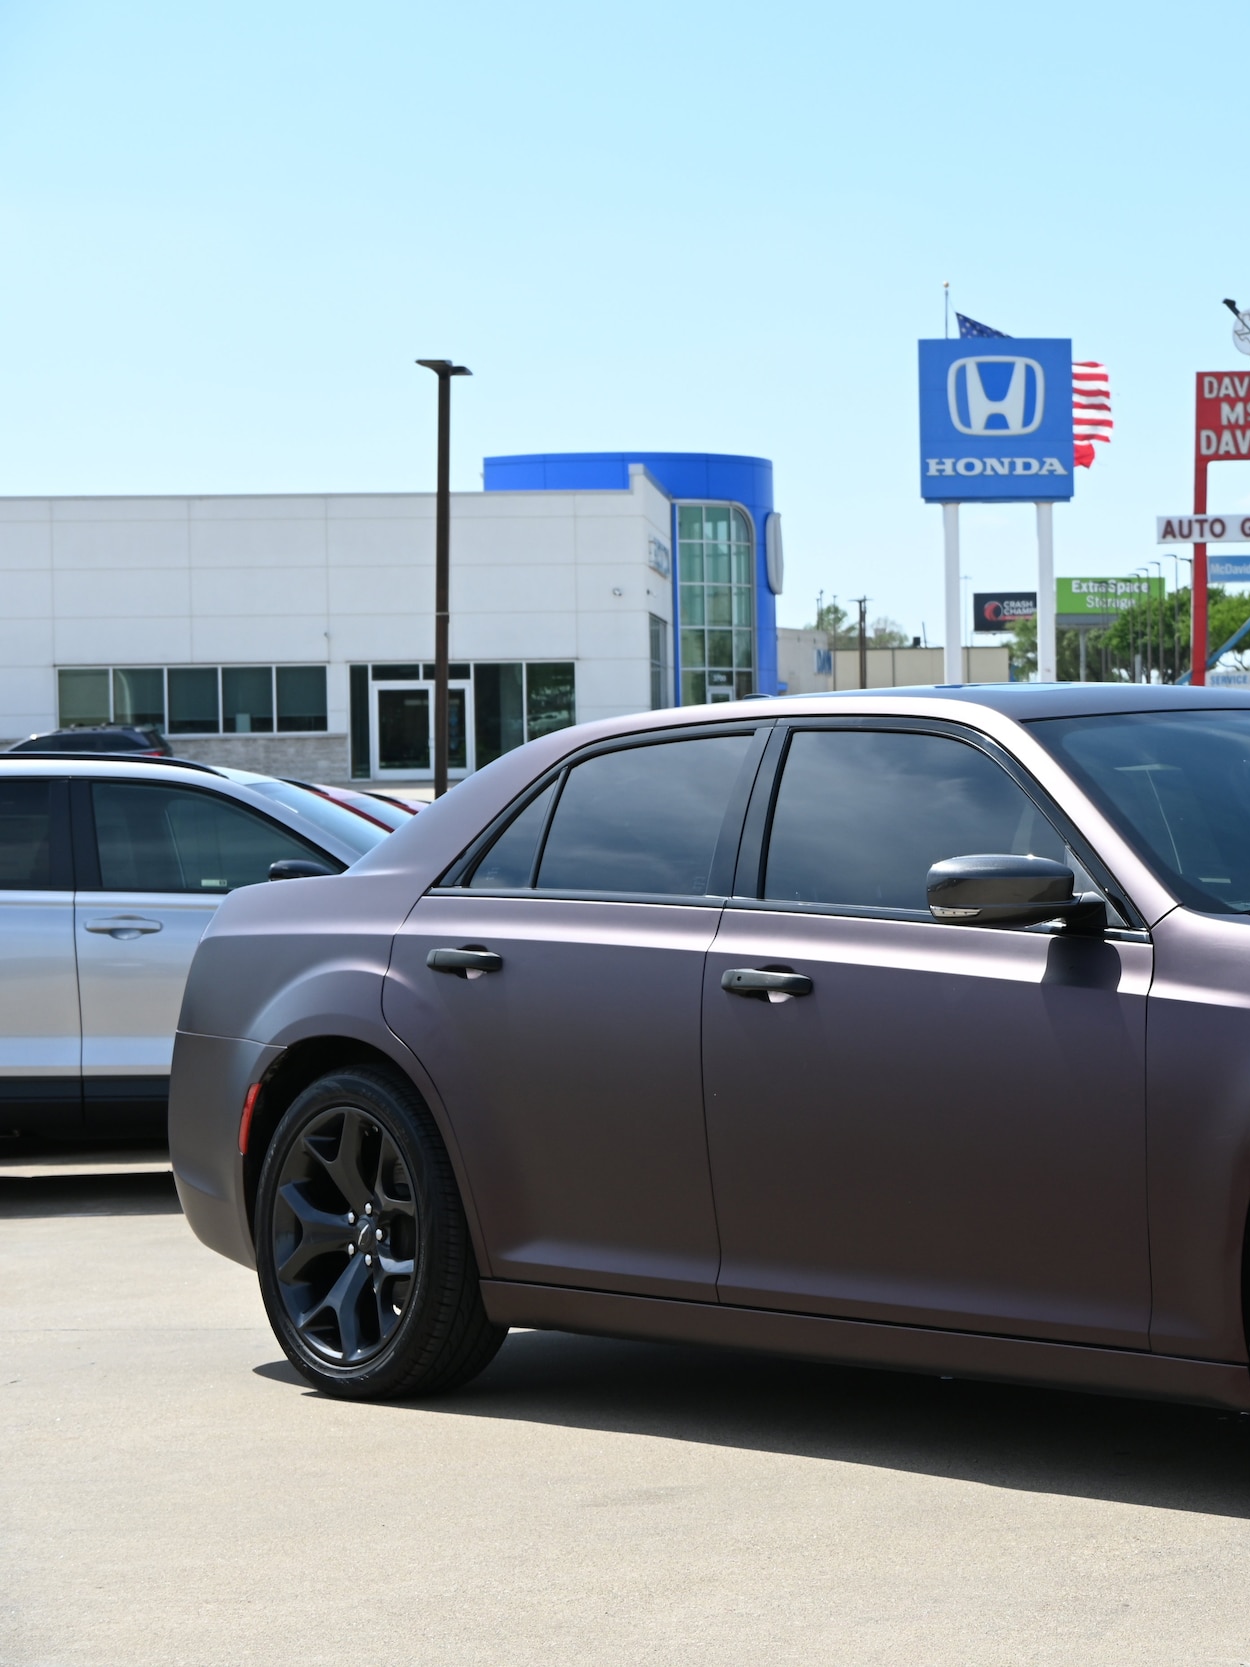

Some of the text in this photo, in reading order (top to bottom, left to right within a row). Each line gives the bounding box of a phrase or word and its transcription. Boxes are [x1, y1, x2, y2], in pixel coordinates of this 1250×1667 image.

[925, 457, 1068, 476] HONDA
[1161, 518, 1226, 540] AUTO
[1003, 600, 1034, 608] CRASH
[1003, 607, 1037, 616] CHAMP
